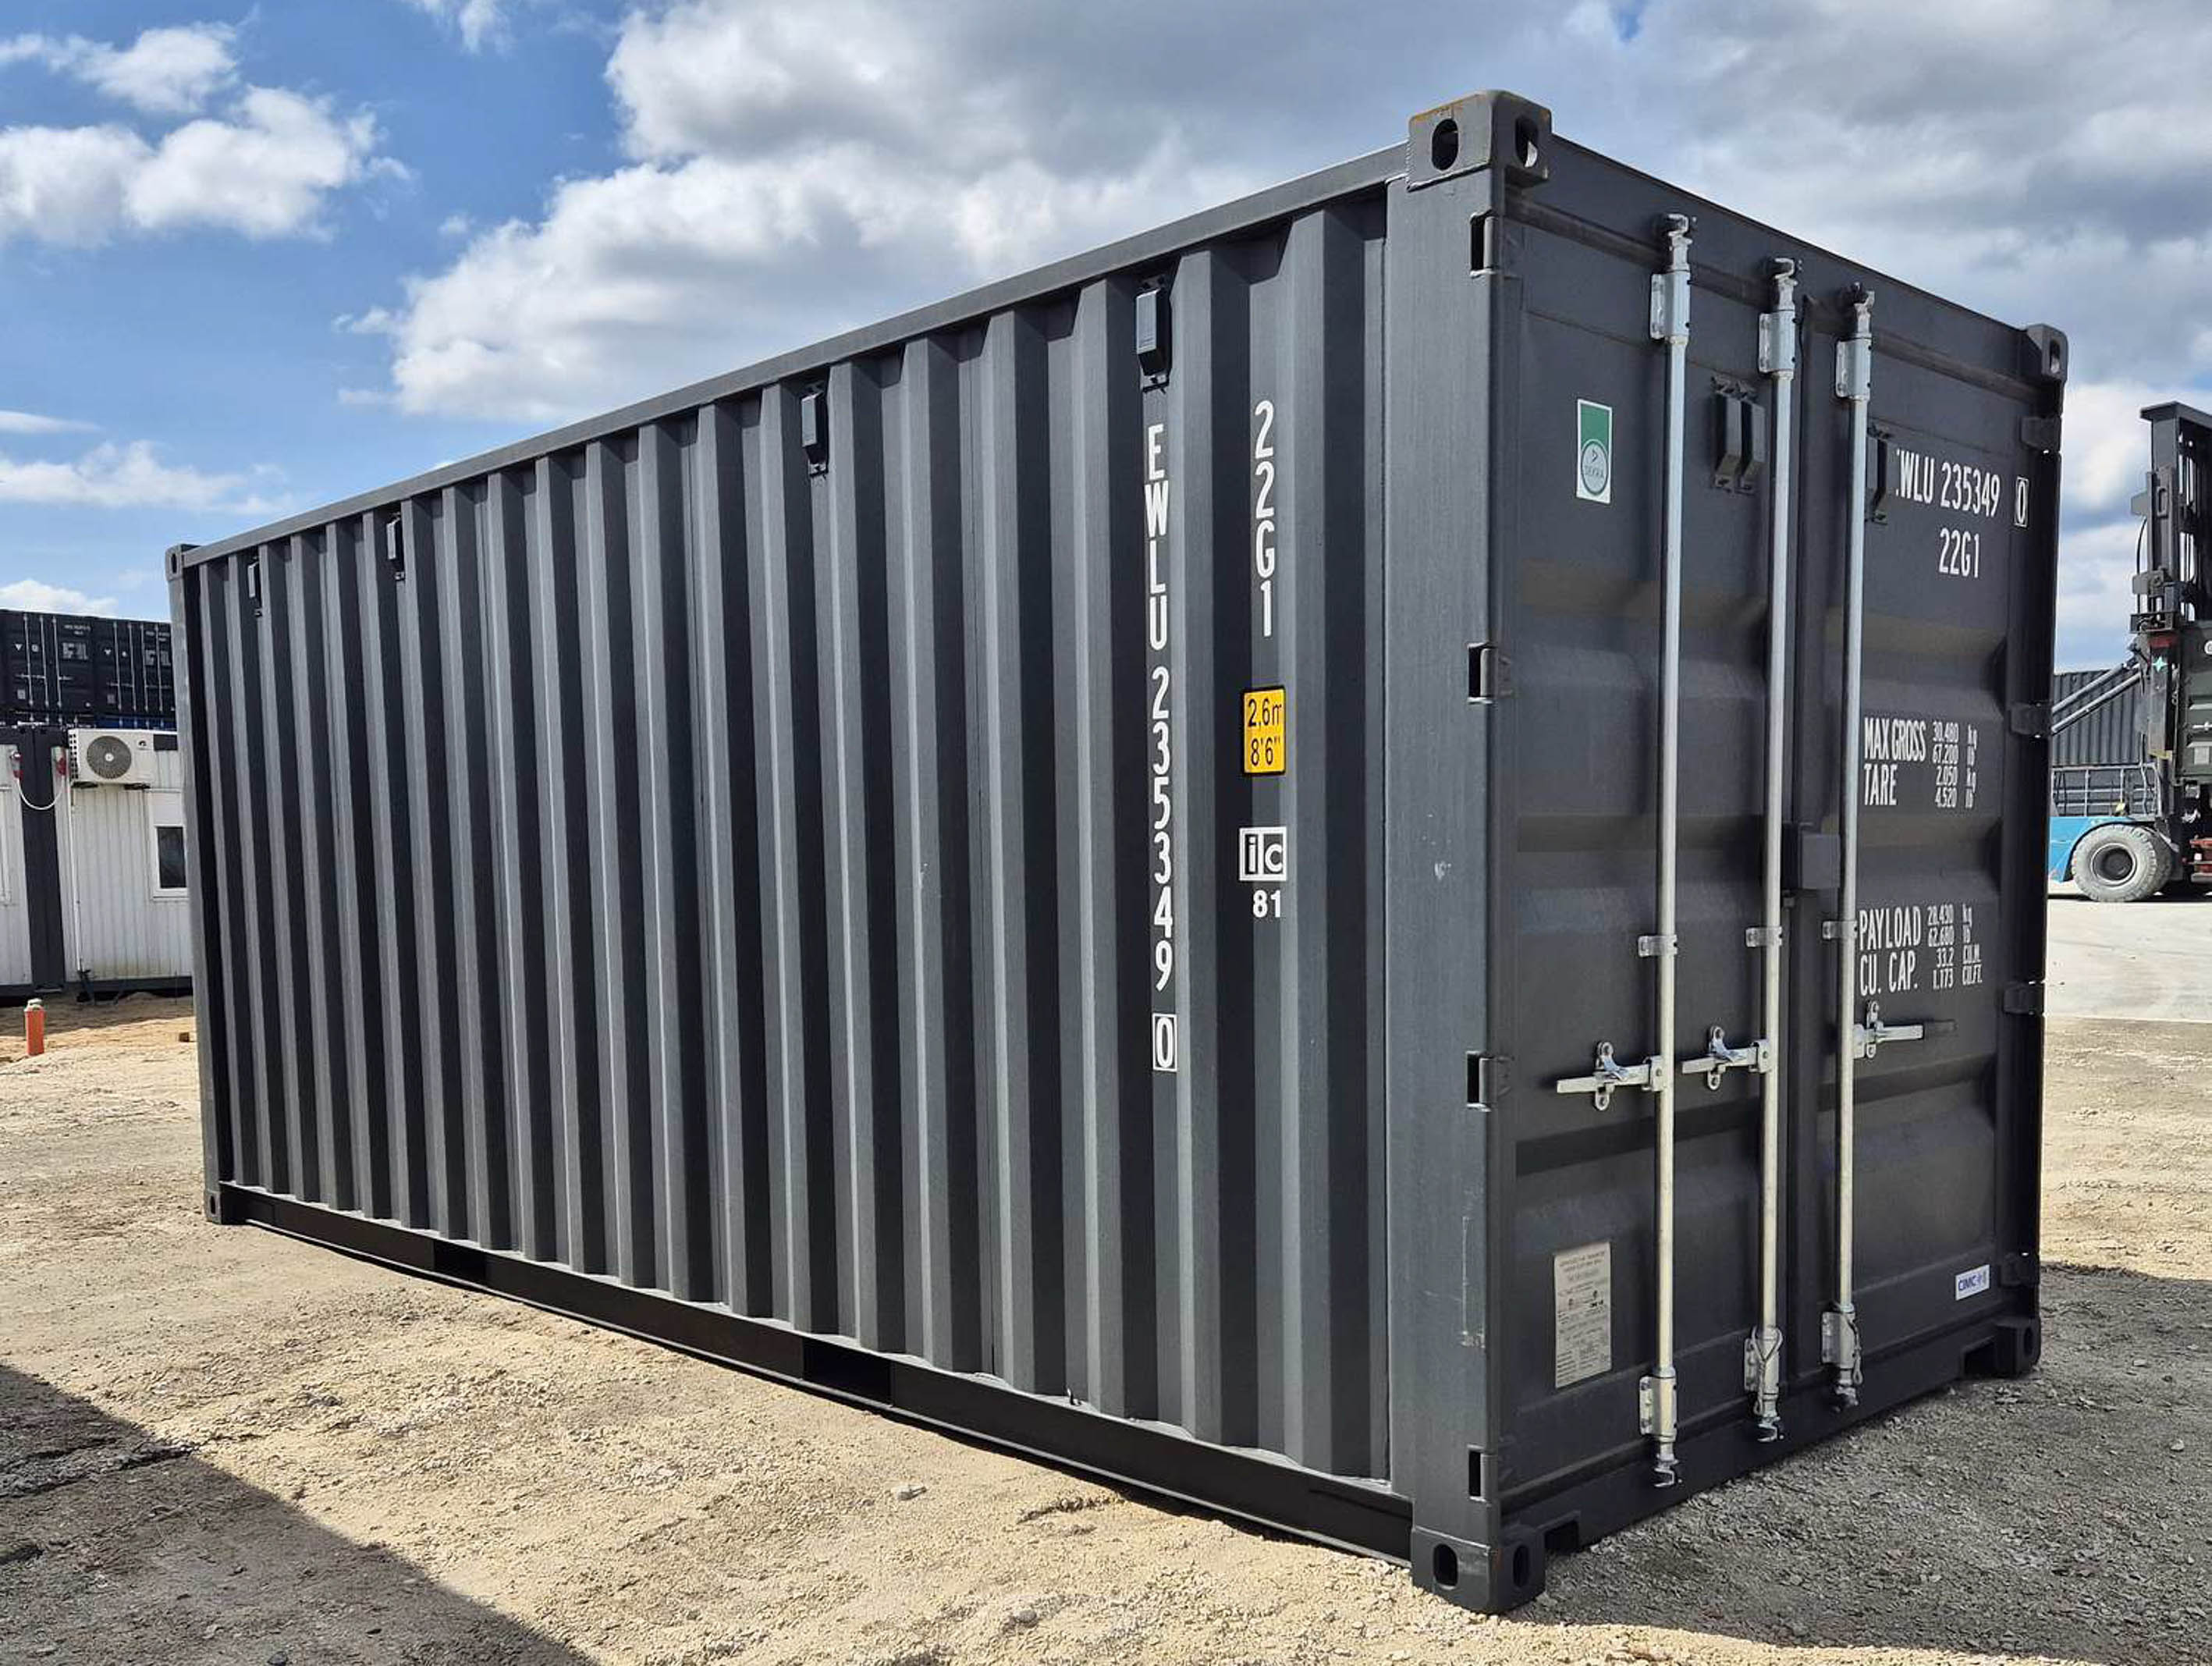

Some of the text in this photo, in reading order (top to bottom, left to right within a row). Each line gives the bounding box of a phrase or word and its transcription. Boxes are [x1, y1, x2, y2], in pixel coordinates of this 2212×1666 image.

[1896, 449, 2028, 526] WLU 235349 0
[1254, 400, 1276, 638] 22G1
[1939, 527, 1980, 579] 22G1
[1144, 423, 1174, 1070] EWLU 235349 0
[1863, 716, 1927, 762] MAX GROSS
[1863, 763, 1898, 806] TARE
[1252, 890, 1281, 918] 81
[1859, 905, 1922, 951] PAYLOAD
[1860, 950, 1918, 996] CU. CAP.
